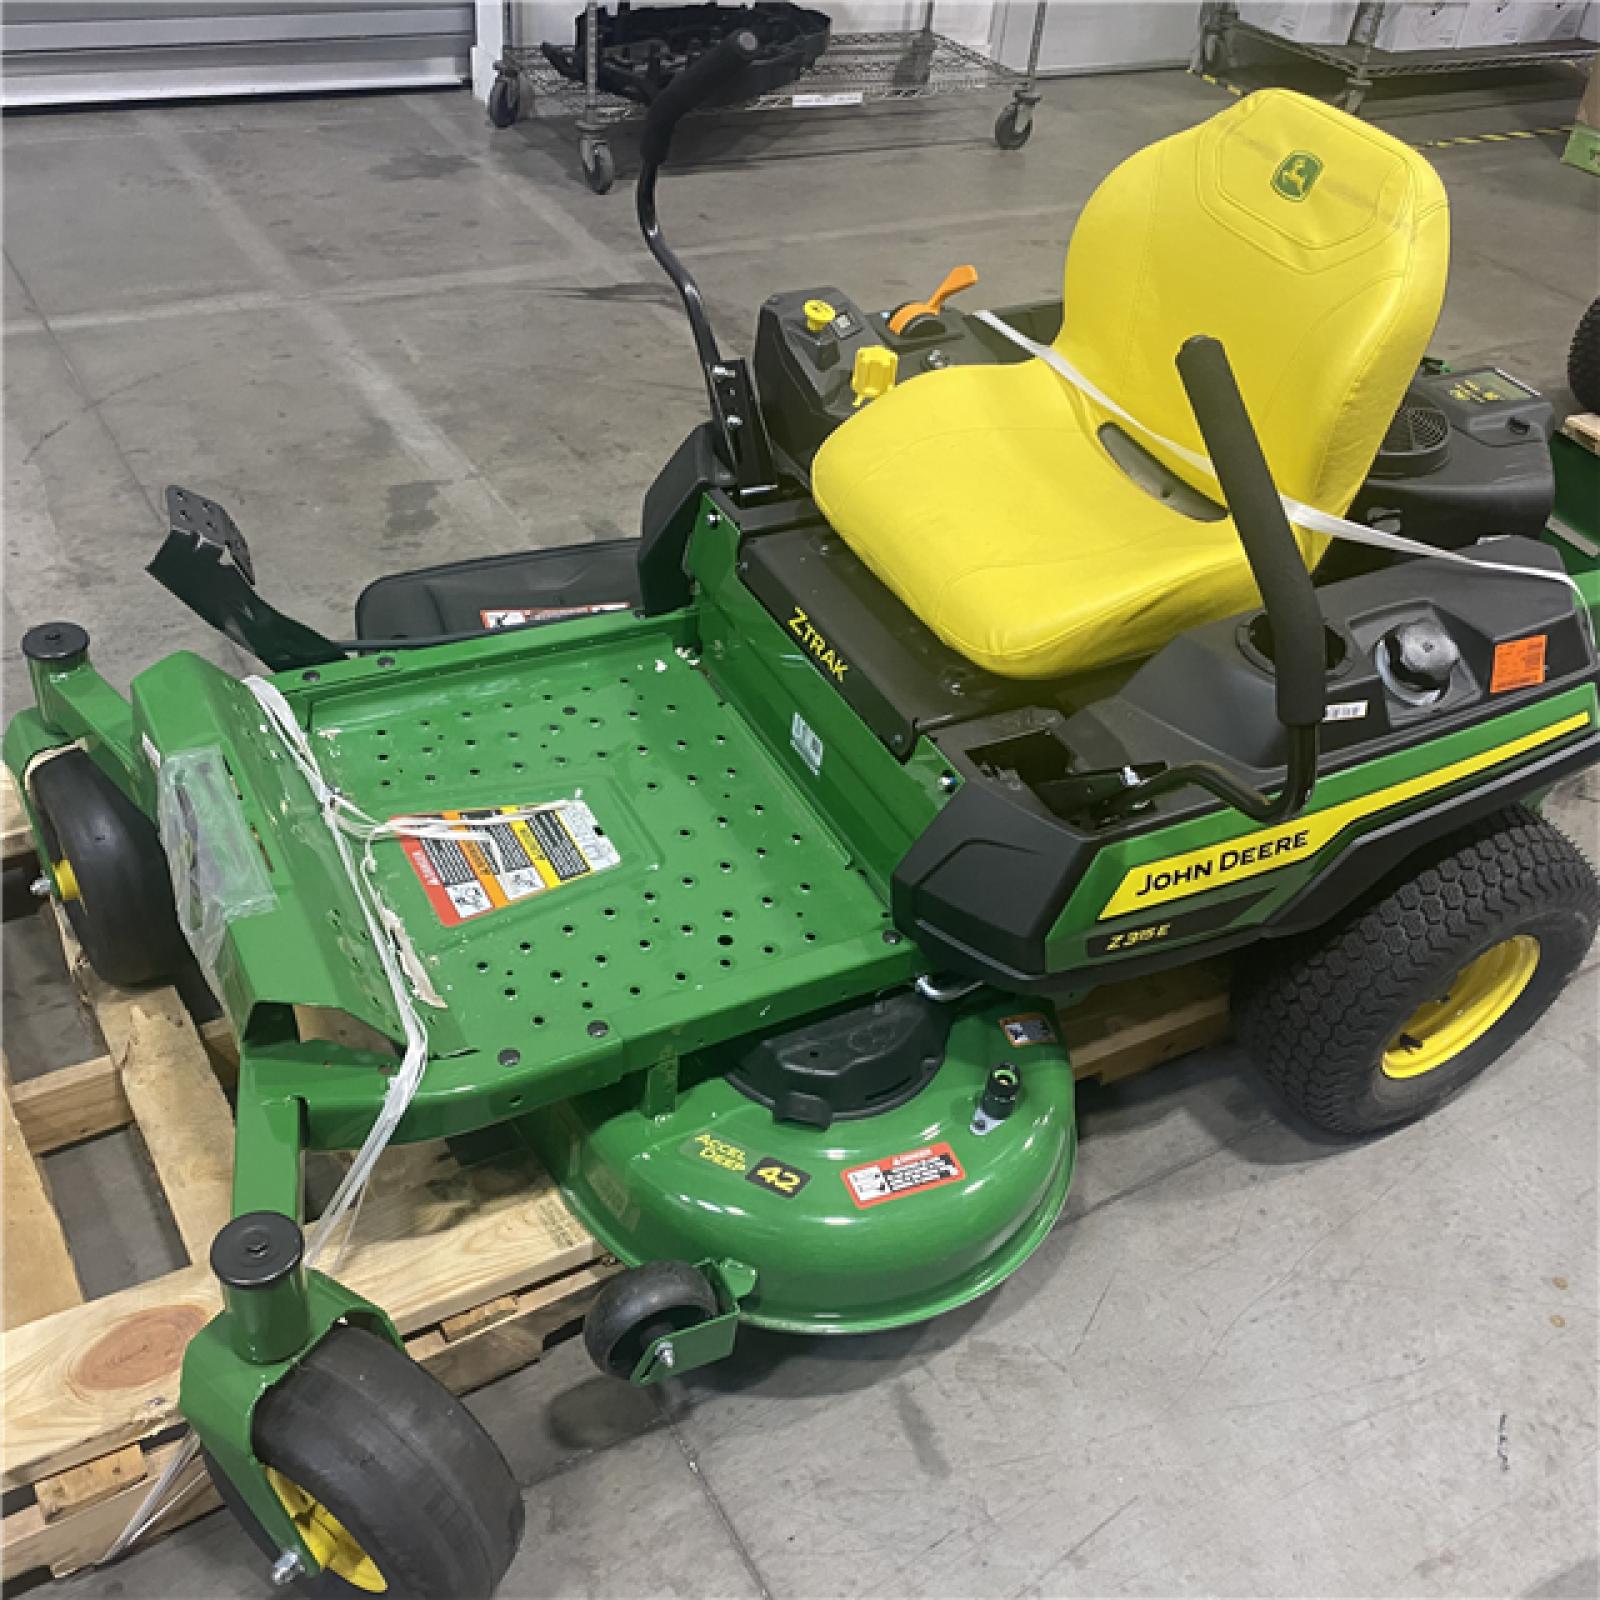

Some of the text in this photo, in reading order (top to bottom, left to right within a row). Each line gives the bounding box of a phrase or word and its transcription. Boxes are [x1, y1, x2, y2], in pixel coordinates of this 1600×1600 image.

[1136, 829, 1310, 896] JOHN DEERE
[756, 1166, 801, 1194] 42
